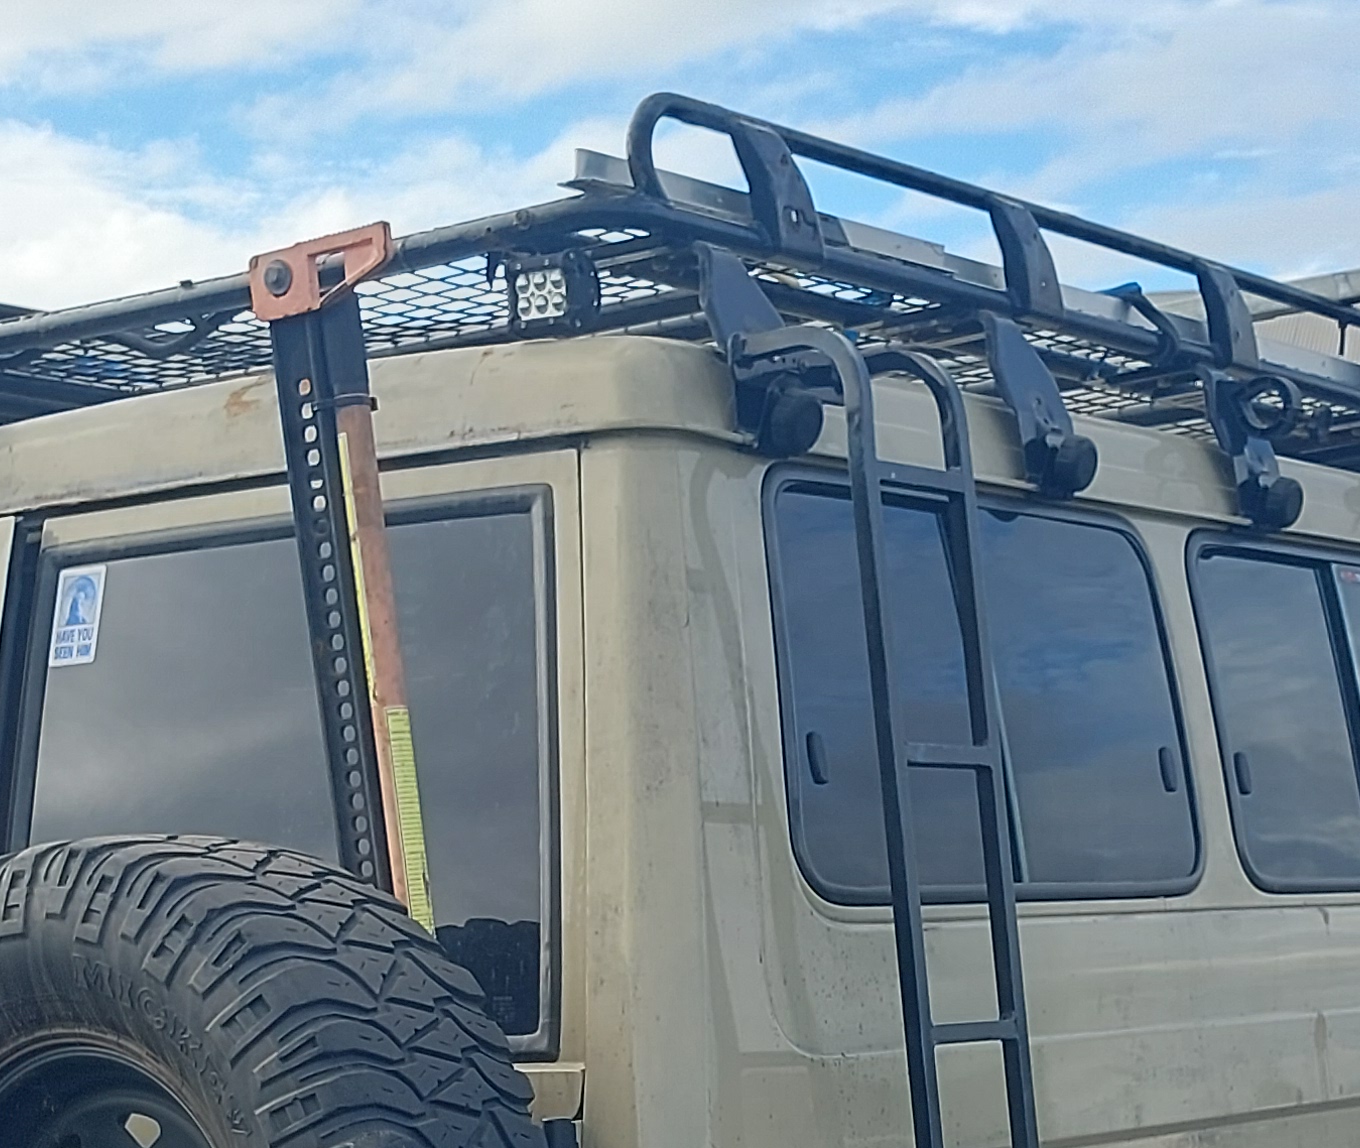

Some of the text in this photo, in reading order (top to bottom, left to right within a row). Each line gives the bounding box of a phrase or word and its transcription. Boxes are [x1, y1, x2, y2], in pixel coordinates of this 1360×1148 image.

[56, 627, 94, 645] HAVE YOU
[54, 645, 74, 659] SEEN
